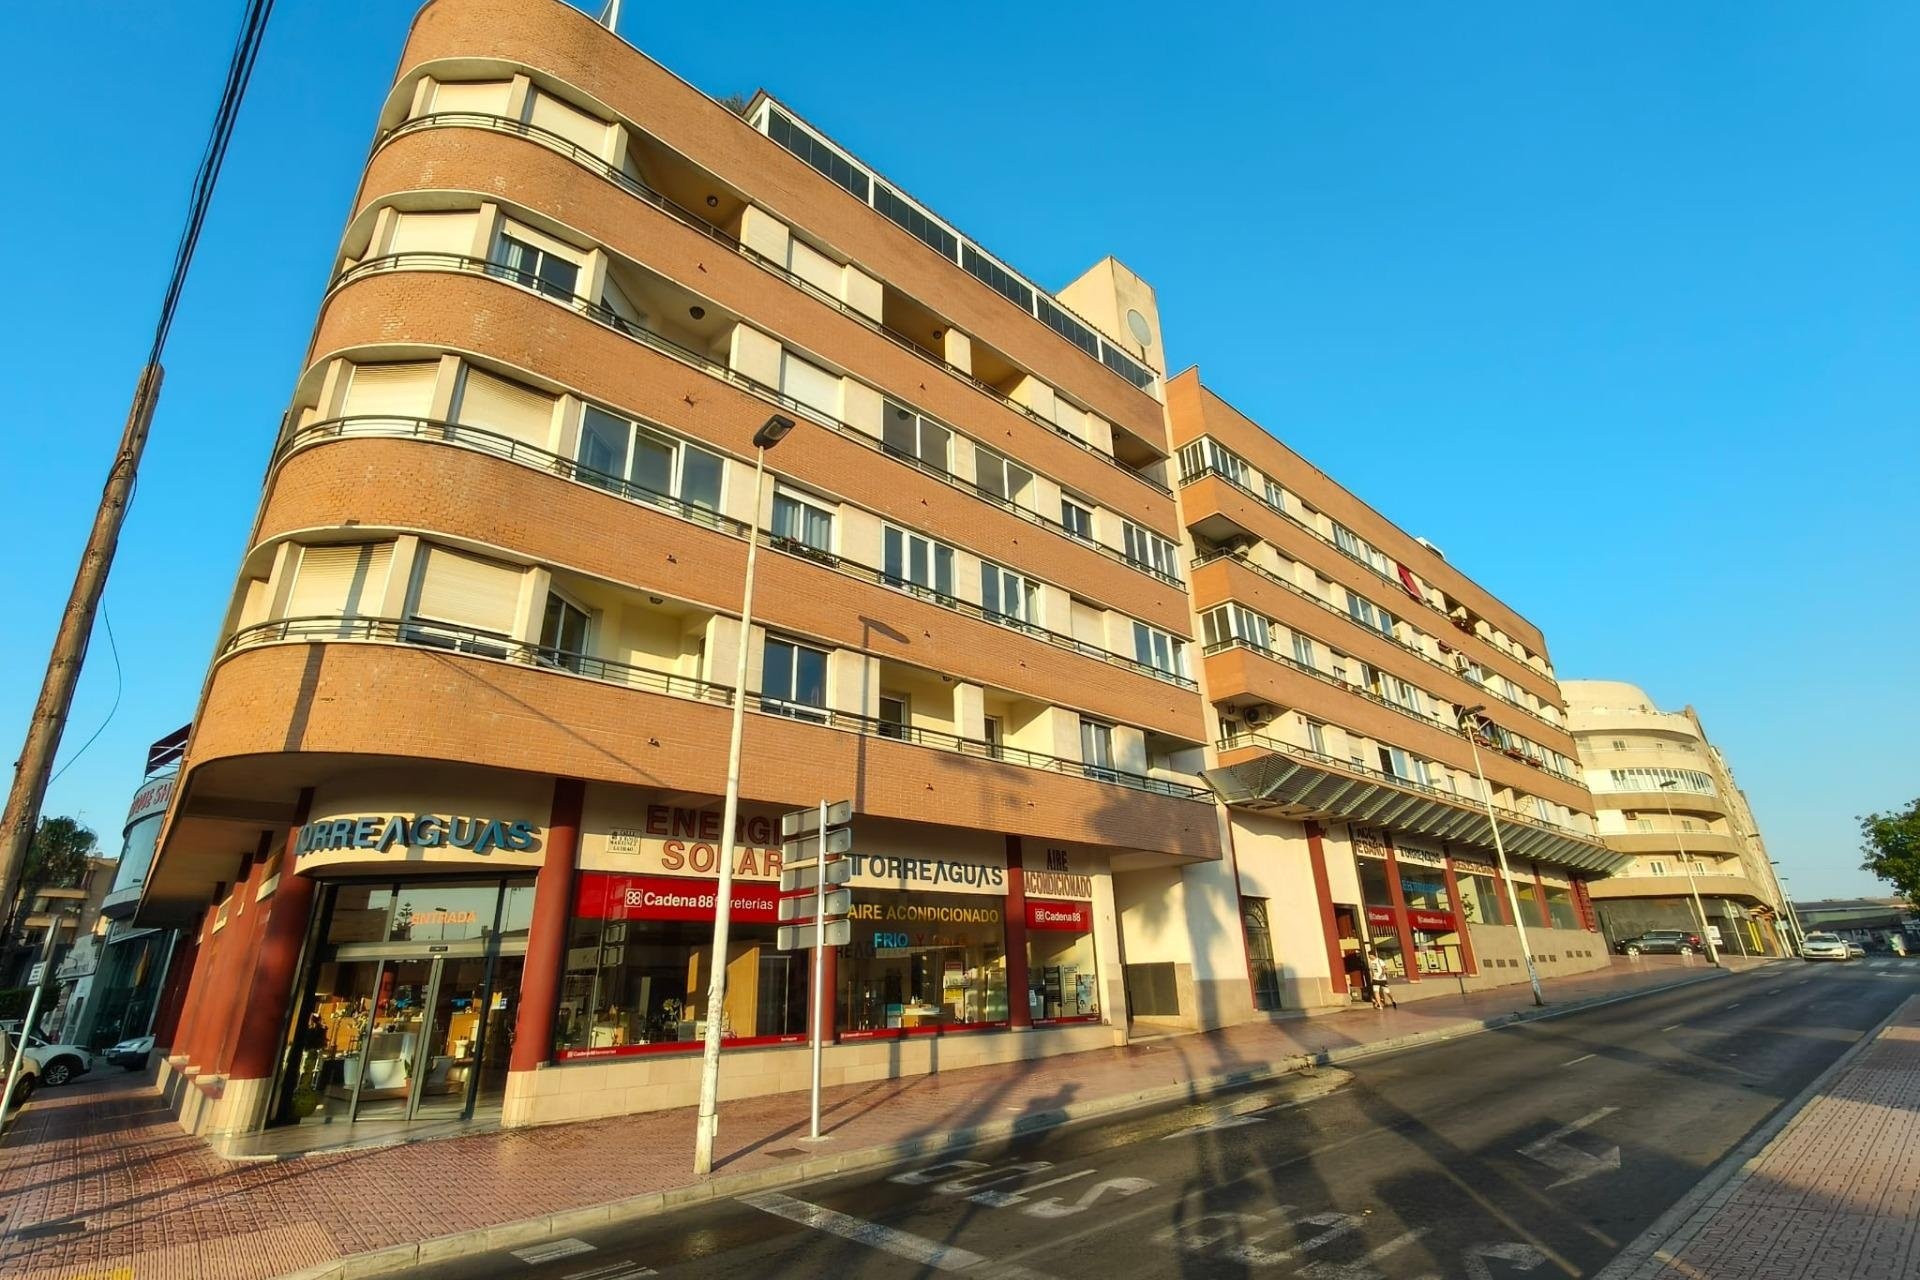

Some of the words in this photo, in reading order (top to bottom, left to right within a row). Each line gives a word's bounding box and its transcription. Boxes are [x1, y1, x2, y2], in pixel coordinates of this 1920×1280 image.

[844, 853, 1003, 888] TORREAGUAS
[1046, 848, 1069, 872] AIRE
[1024, 871, 1092, 898] ACONDICIONADO
[411, 911, 478, 925] ENTRADA
[847, 903, 883, 920] AIRE
[886, 903, 999, 923] ACONDICIONADO
